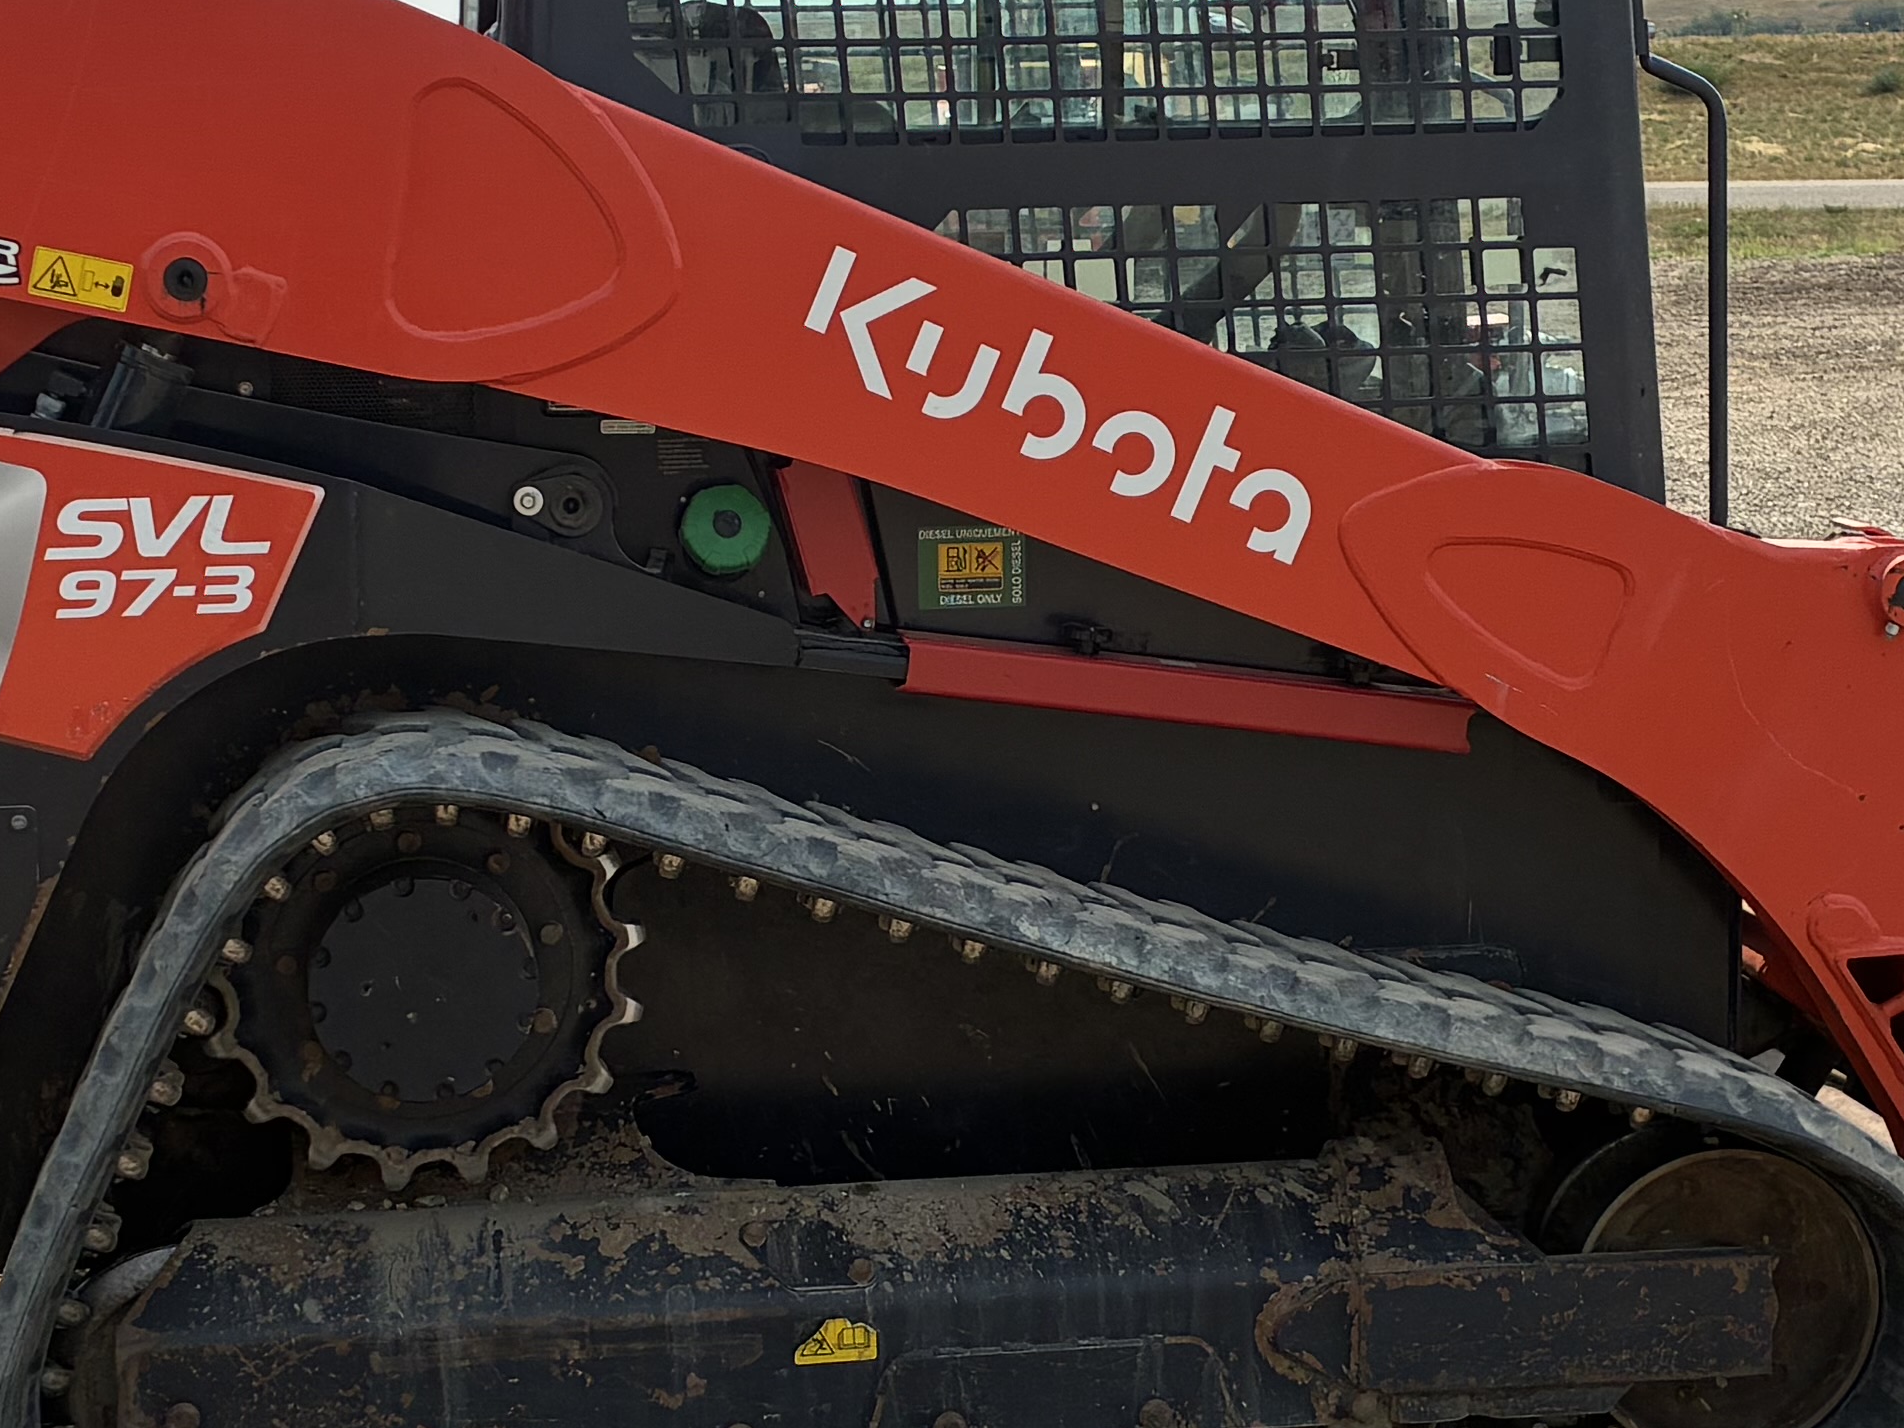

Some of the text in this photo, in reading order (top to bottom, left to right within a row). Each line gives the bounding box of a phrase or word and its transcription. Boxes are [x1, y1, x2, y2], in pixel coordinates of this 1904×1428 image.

[804, 245, 1312, 566] Kubota
[44, 495, 271, 561] SVL
[918, 529, 954, 540] DIESEL
[56, 565, 255, 619] 97-3
[939, 593, 1003, 606] DIESEL ONLY
[1010, 539, 1022, 604] SOLO DIESEL
